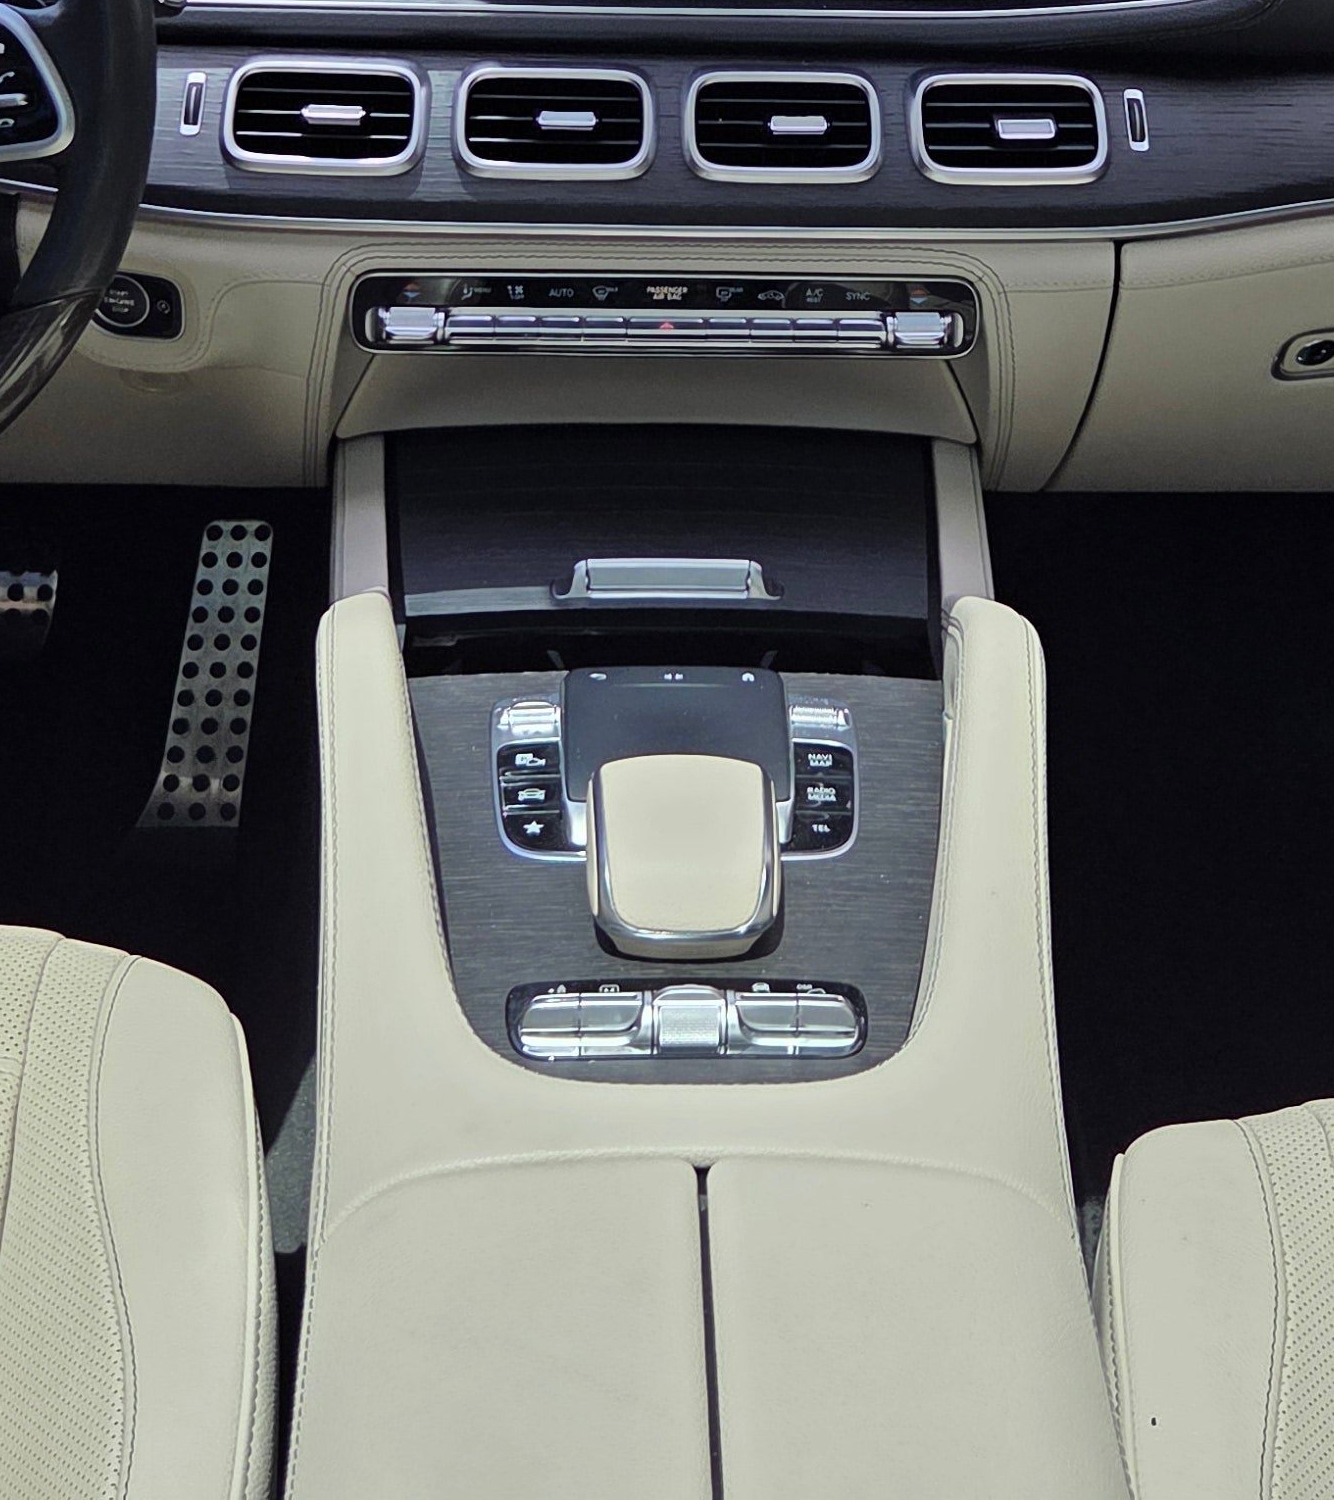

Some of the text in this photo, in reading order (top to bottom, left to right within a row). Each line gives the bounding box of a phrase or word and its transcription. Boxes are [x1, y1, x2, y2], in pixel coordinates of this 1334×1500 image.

[548, 288, 574, 298] AUTO
[805, 288, 824, 297] A/C
[845, 291, 871, 301] SYNC
[808, 753, 833, 761] NAVI
[807, 786, 836, 794] RADIO
[811, 824, 831, 833] TEL
